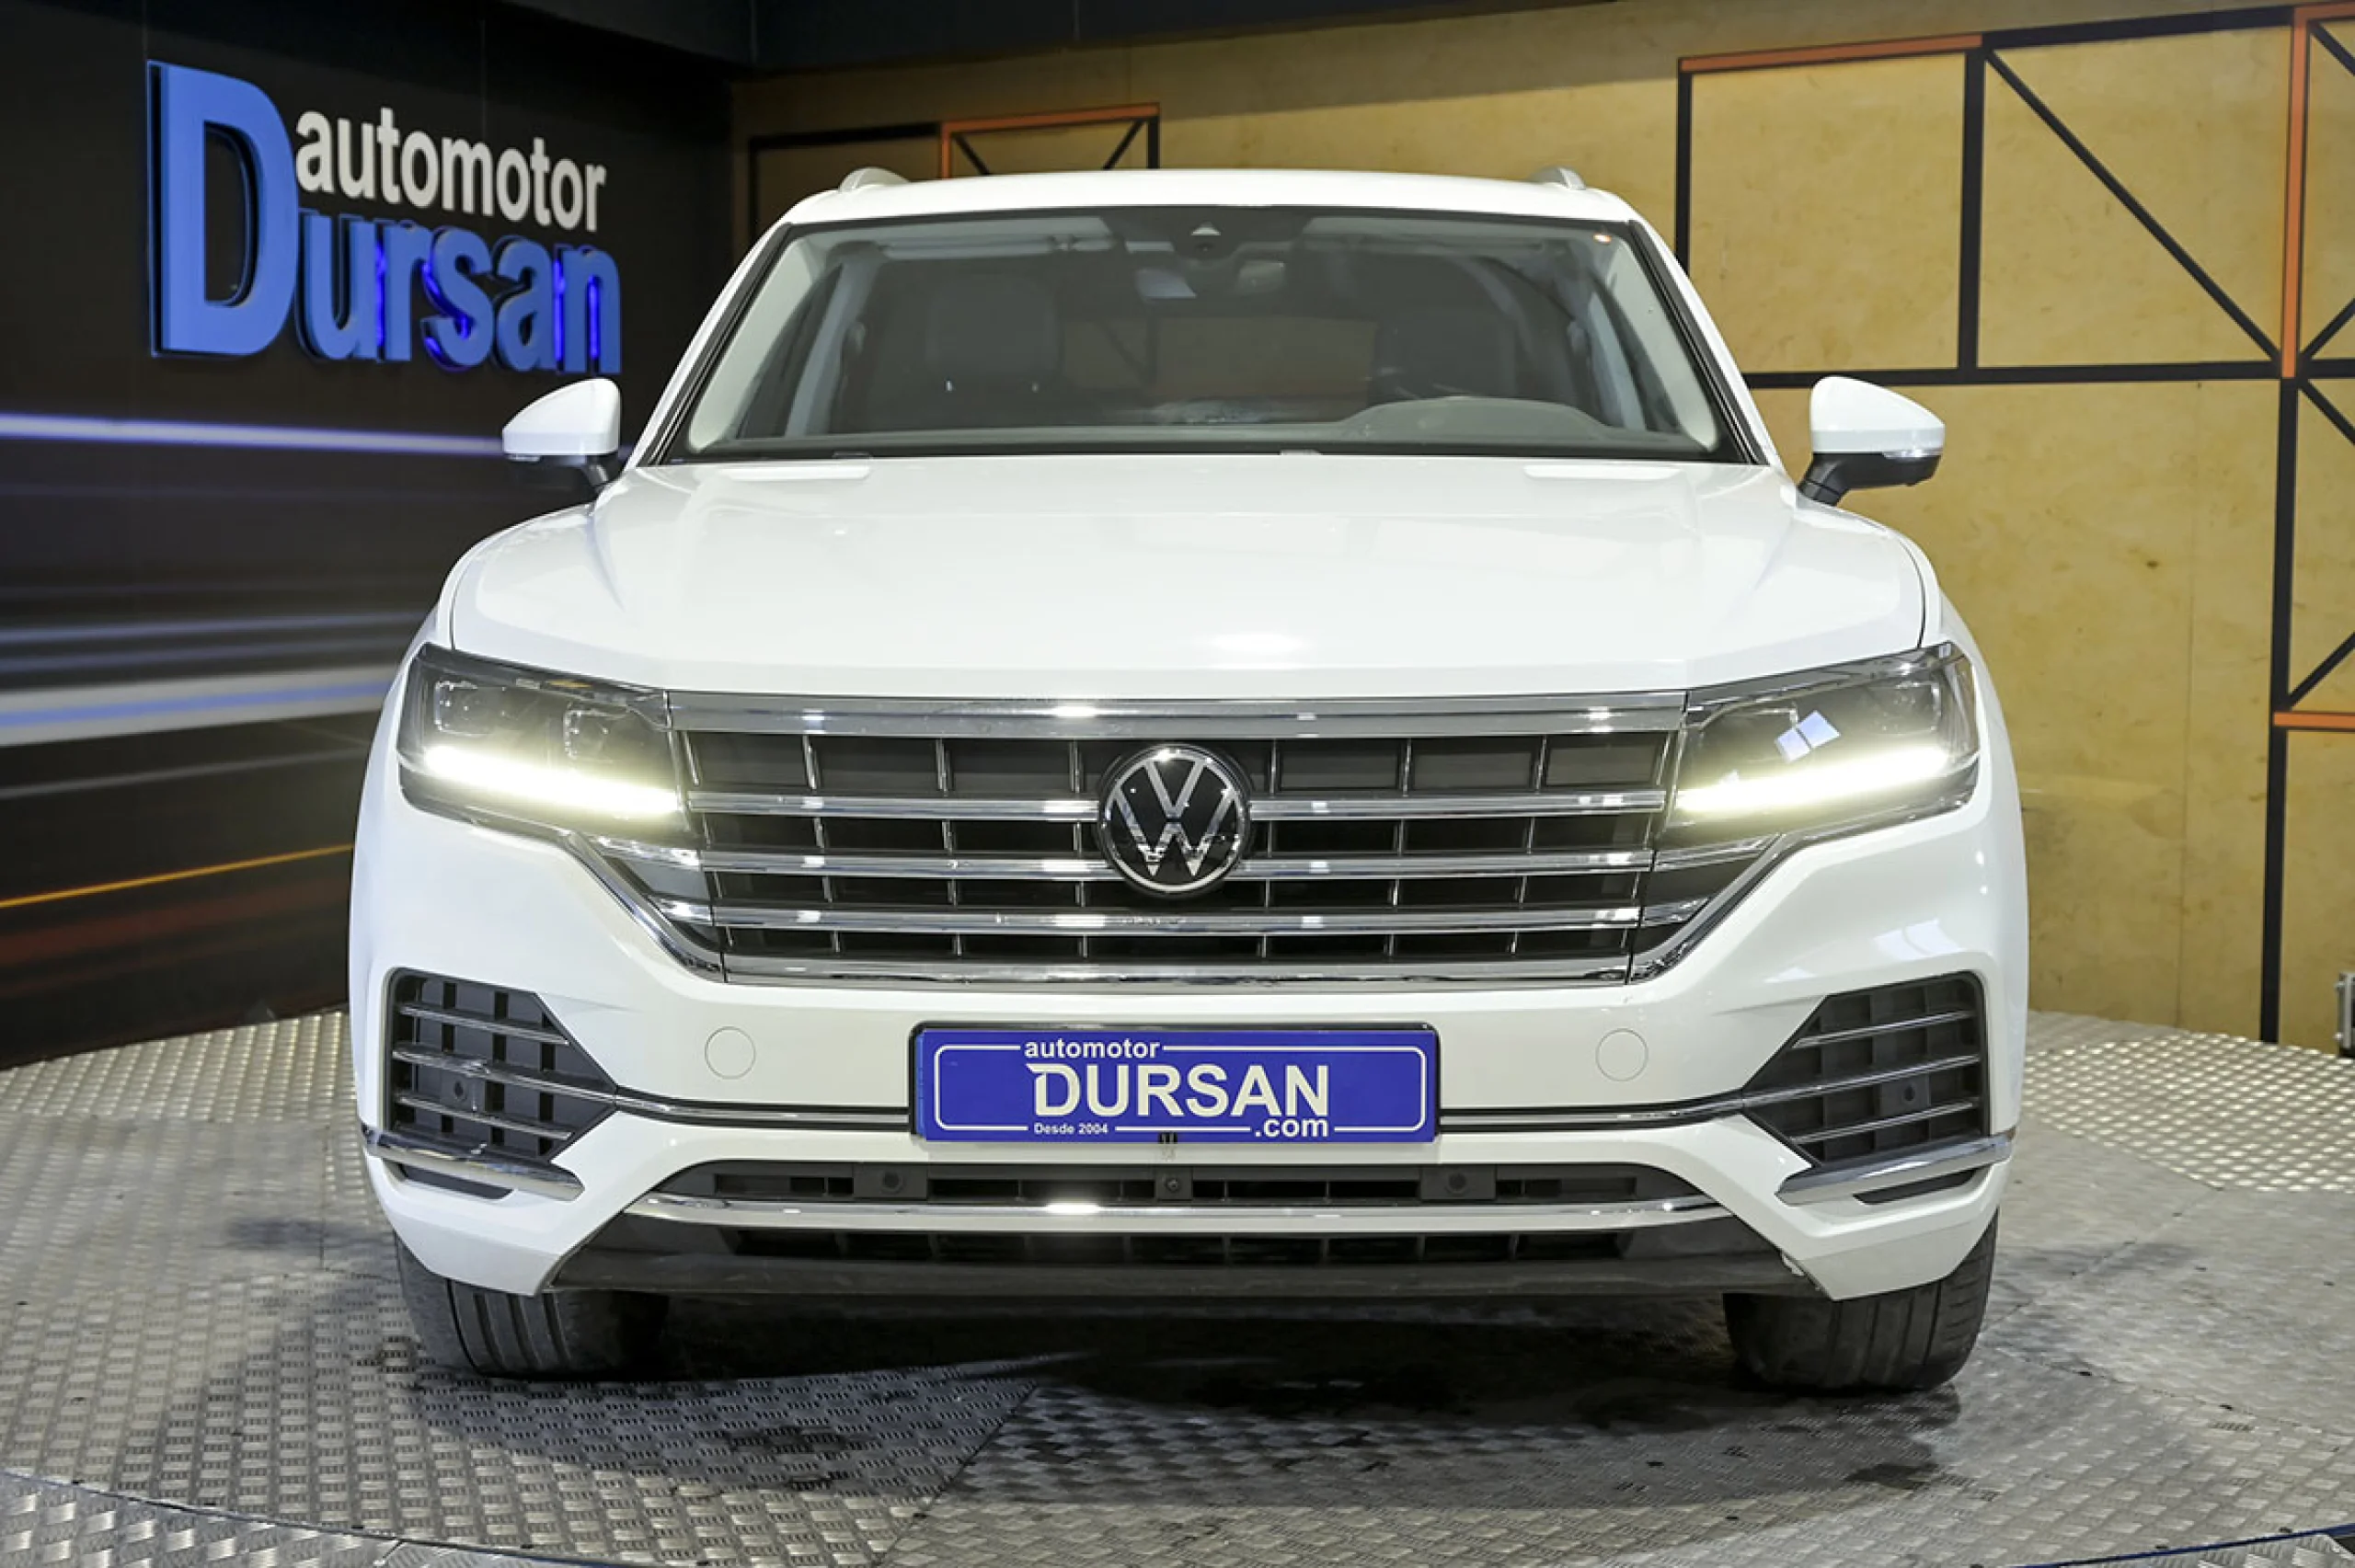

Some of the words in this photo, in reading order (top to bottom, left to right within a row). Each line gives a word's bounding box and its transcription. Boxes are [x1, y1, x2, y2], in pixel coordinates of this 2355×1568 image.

[296, 107, 605, 231] automotor
[148, 61, 621, 374] Dursan
[1108, 754, 1239, 877] VW
[1024, 1038, 1160, 1058] automotor
[1026, 1063, 1328, 1117] DURSAN
[1034, 1122, 1074, 1135] Desde
[1078, 1122, 1109, 1135] 2004
[1255, 1116, 1328, 1138] .com
